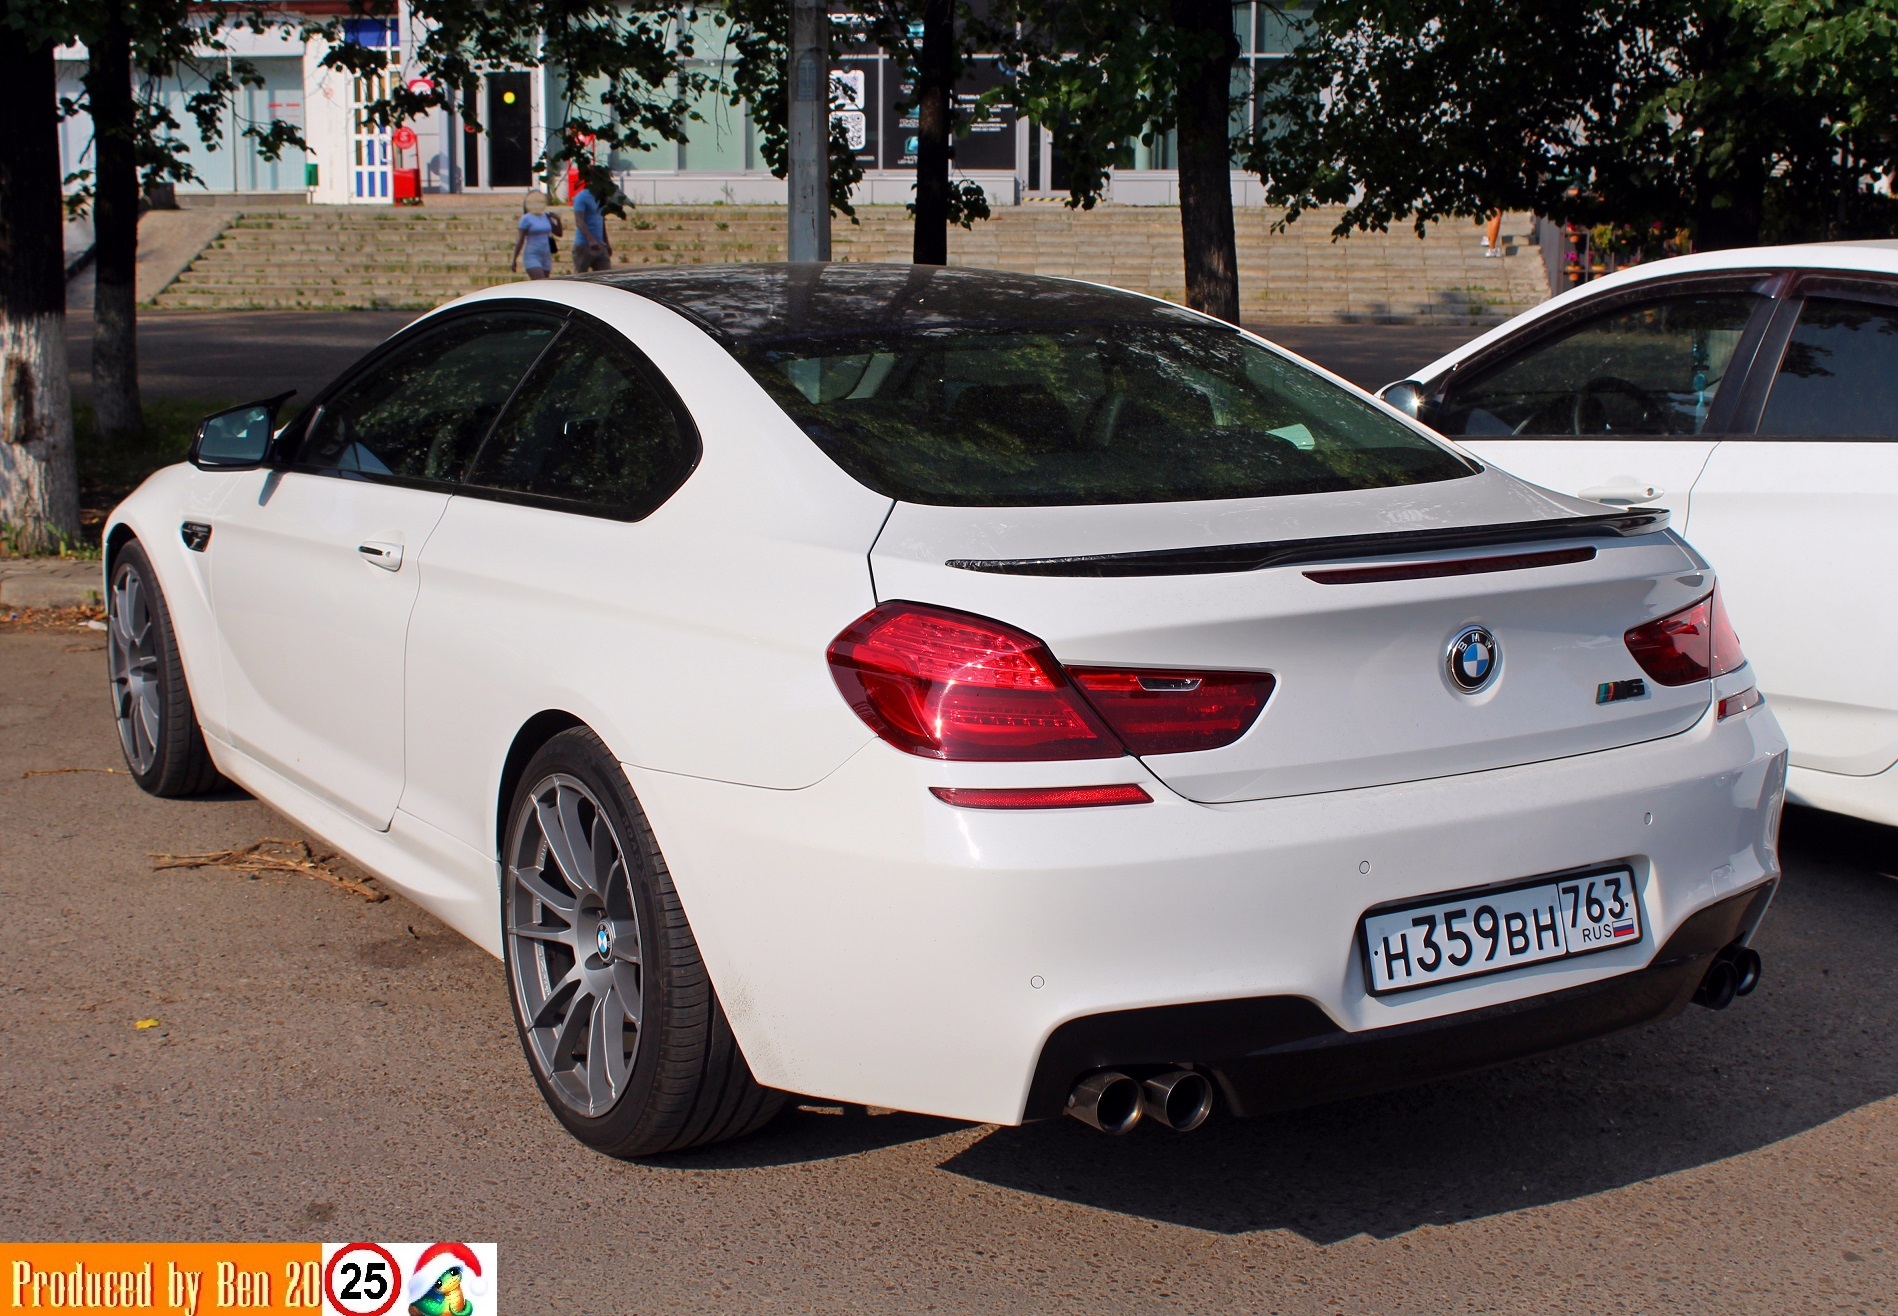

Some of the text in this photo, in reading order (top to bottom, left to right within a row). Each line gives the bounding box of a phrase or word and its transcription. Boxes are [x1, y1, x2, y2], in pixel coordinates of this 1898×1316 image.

[1458, 631, 1492, 651] BMW
[1382, 877, 1625, 980] Н359ВН 763
[1582, 924, 1613, 943] RUS
